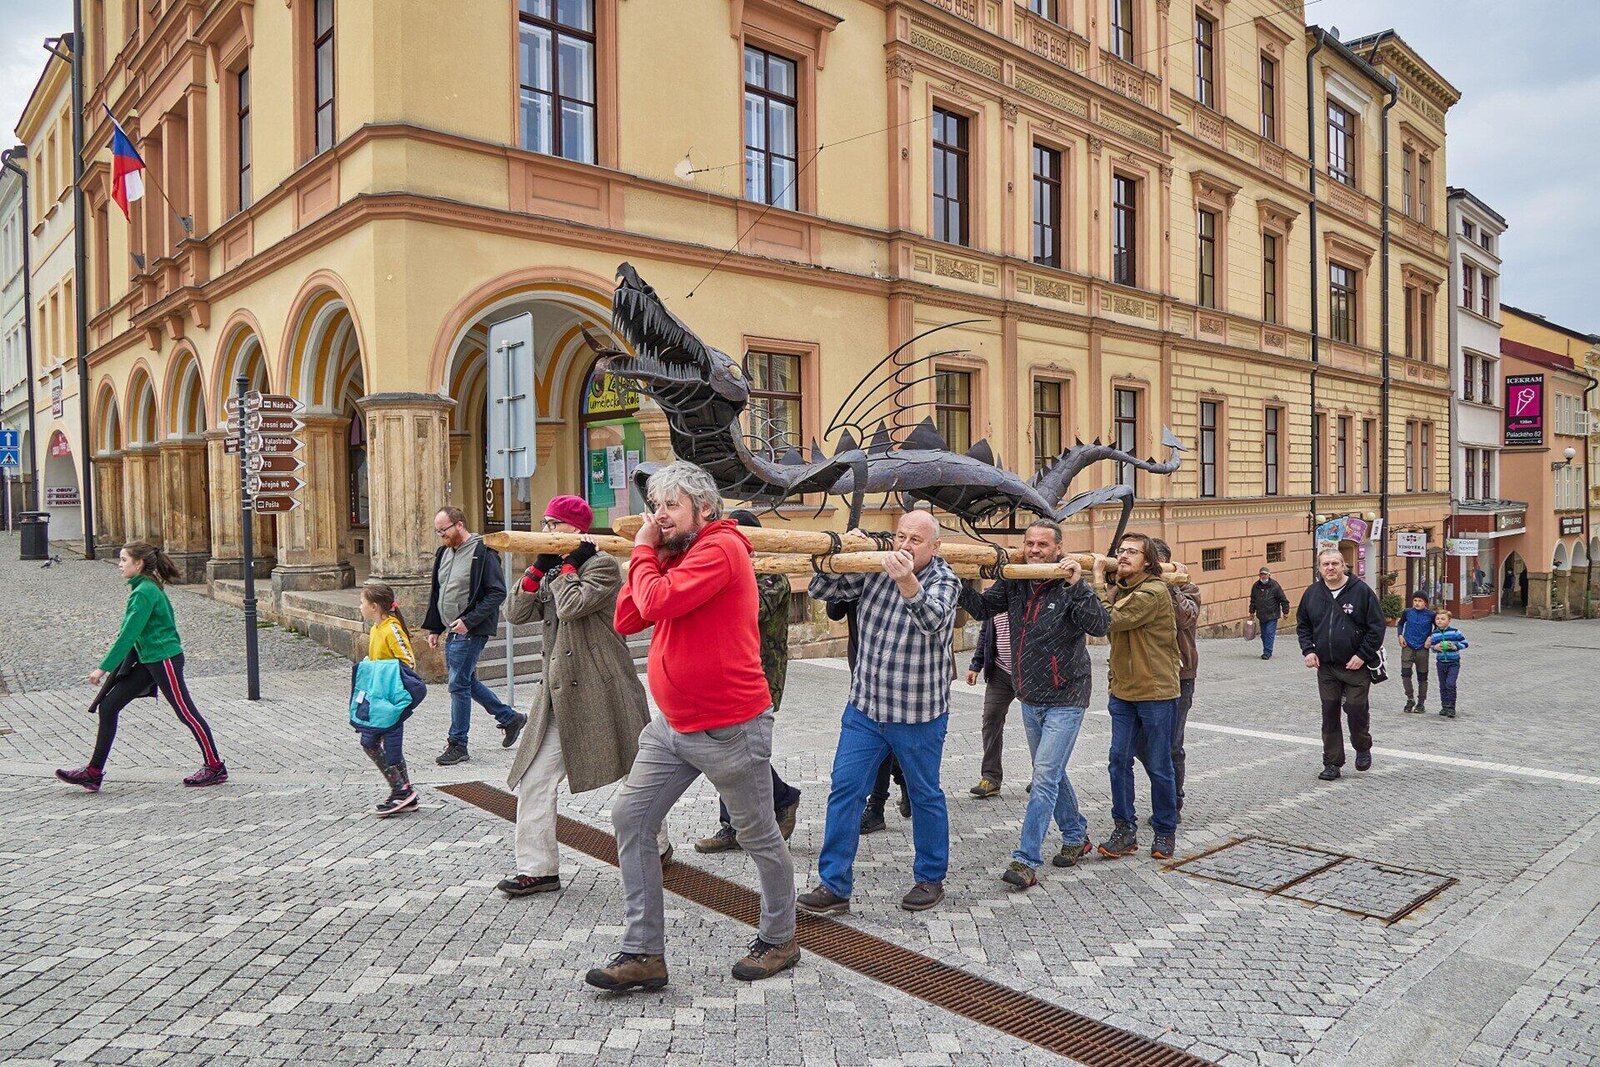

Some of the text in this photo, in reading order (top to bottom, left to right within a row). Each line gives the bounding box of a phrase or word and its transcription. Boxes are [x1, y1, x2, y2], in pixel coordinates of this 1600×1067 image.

[272, 400, 294, 409] Nádraží
[261, 480, 279, 490] eřejné
[280, 480, 290, 488] WC
[265, 500, 280, 508] Pošta
